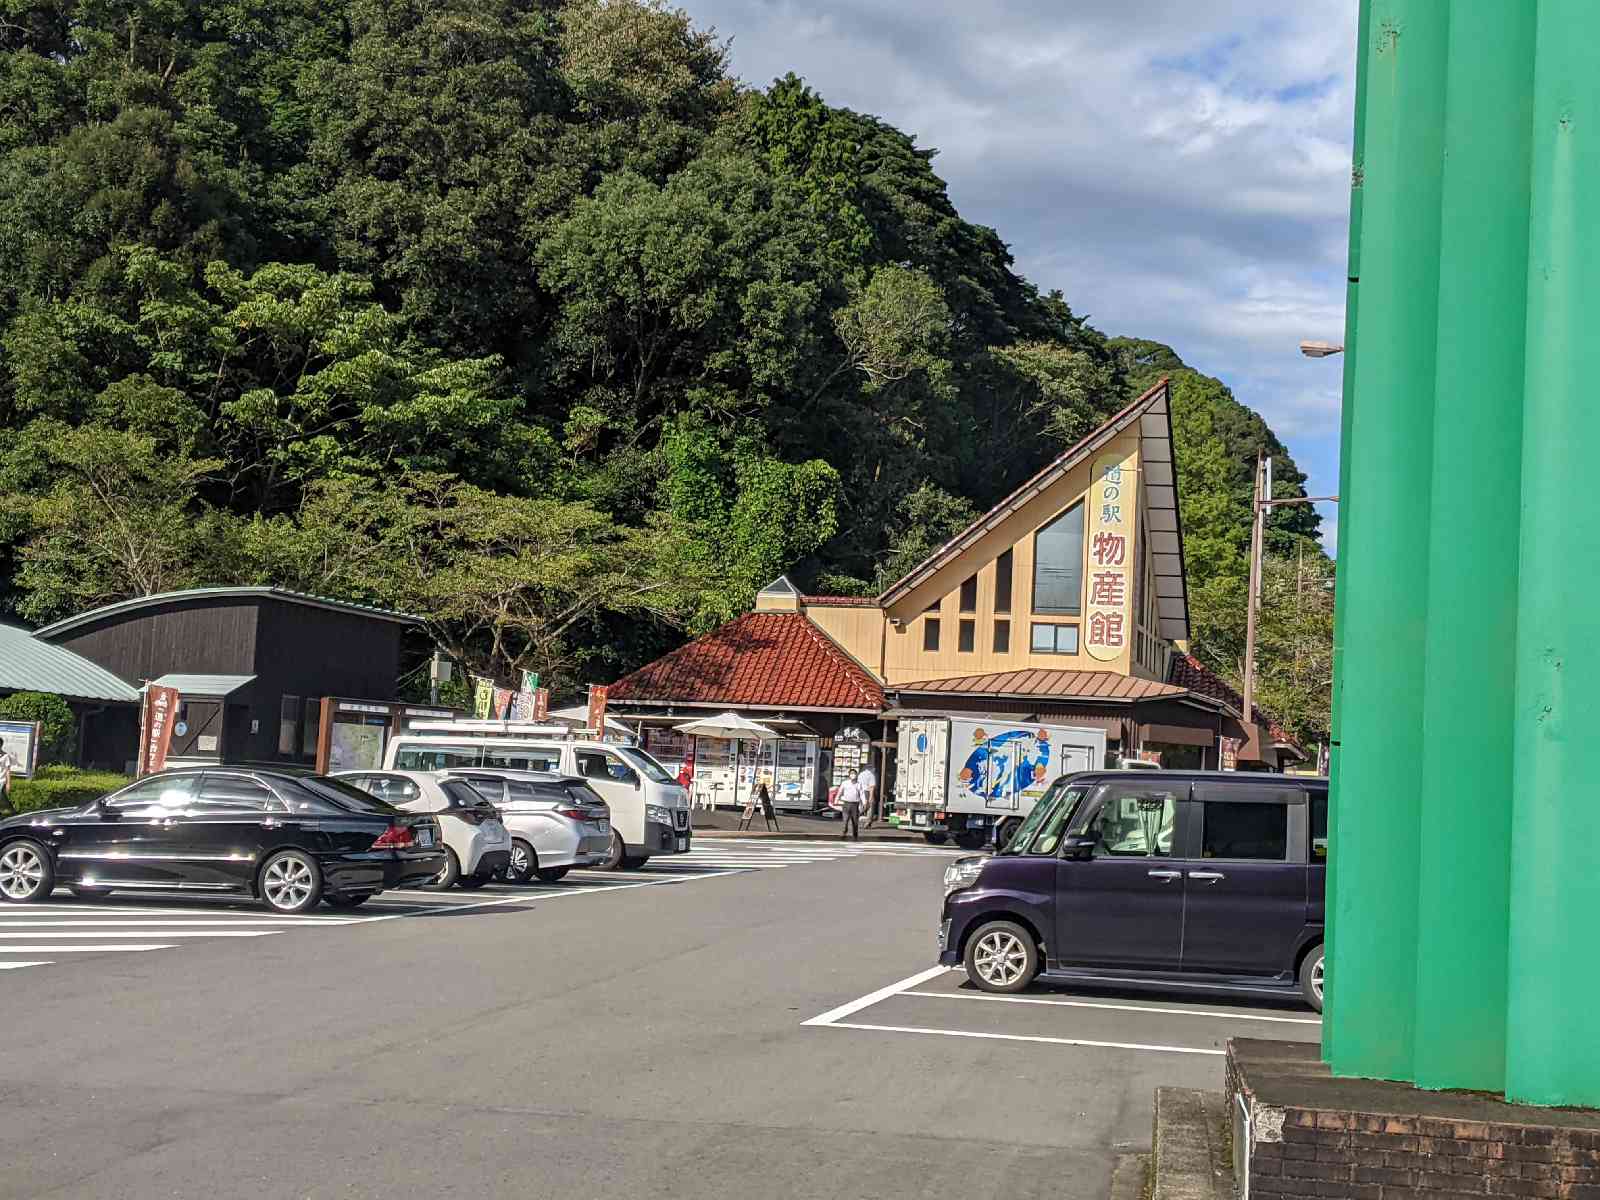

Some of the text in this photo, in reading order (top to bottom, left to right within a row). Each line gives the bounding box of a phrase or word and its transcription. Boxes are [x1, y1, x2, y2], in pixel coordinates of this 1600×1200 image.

[1100, 463, 1122, 523] 道の駅
[1089, 531, 1126, 647] 物産館
